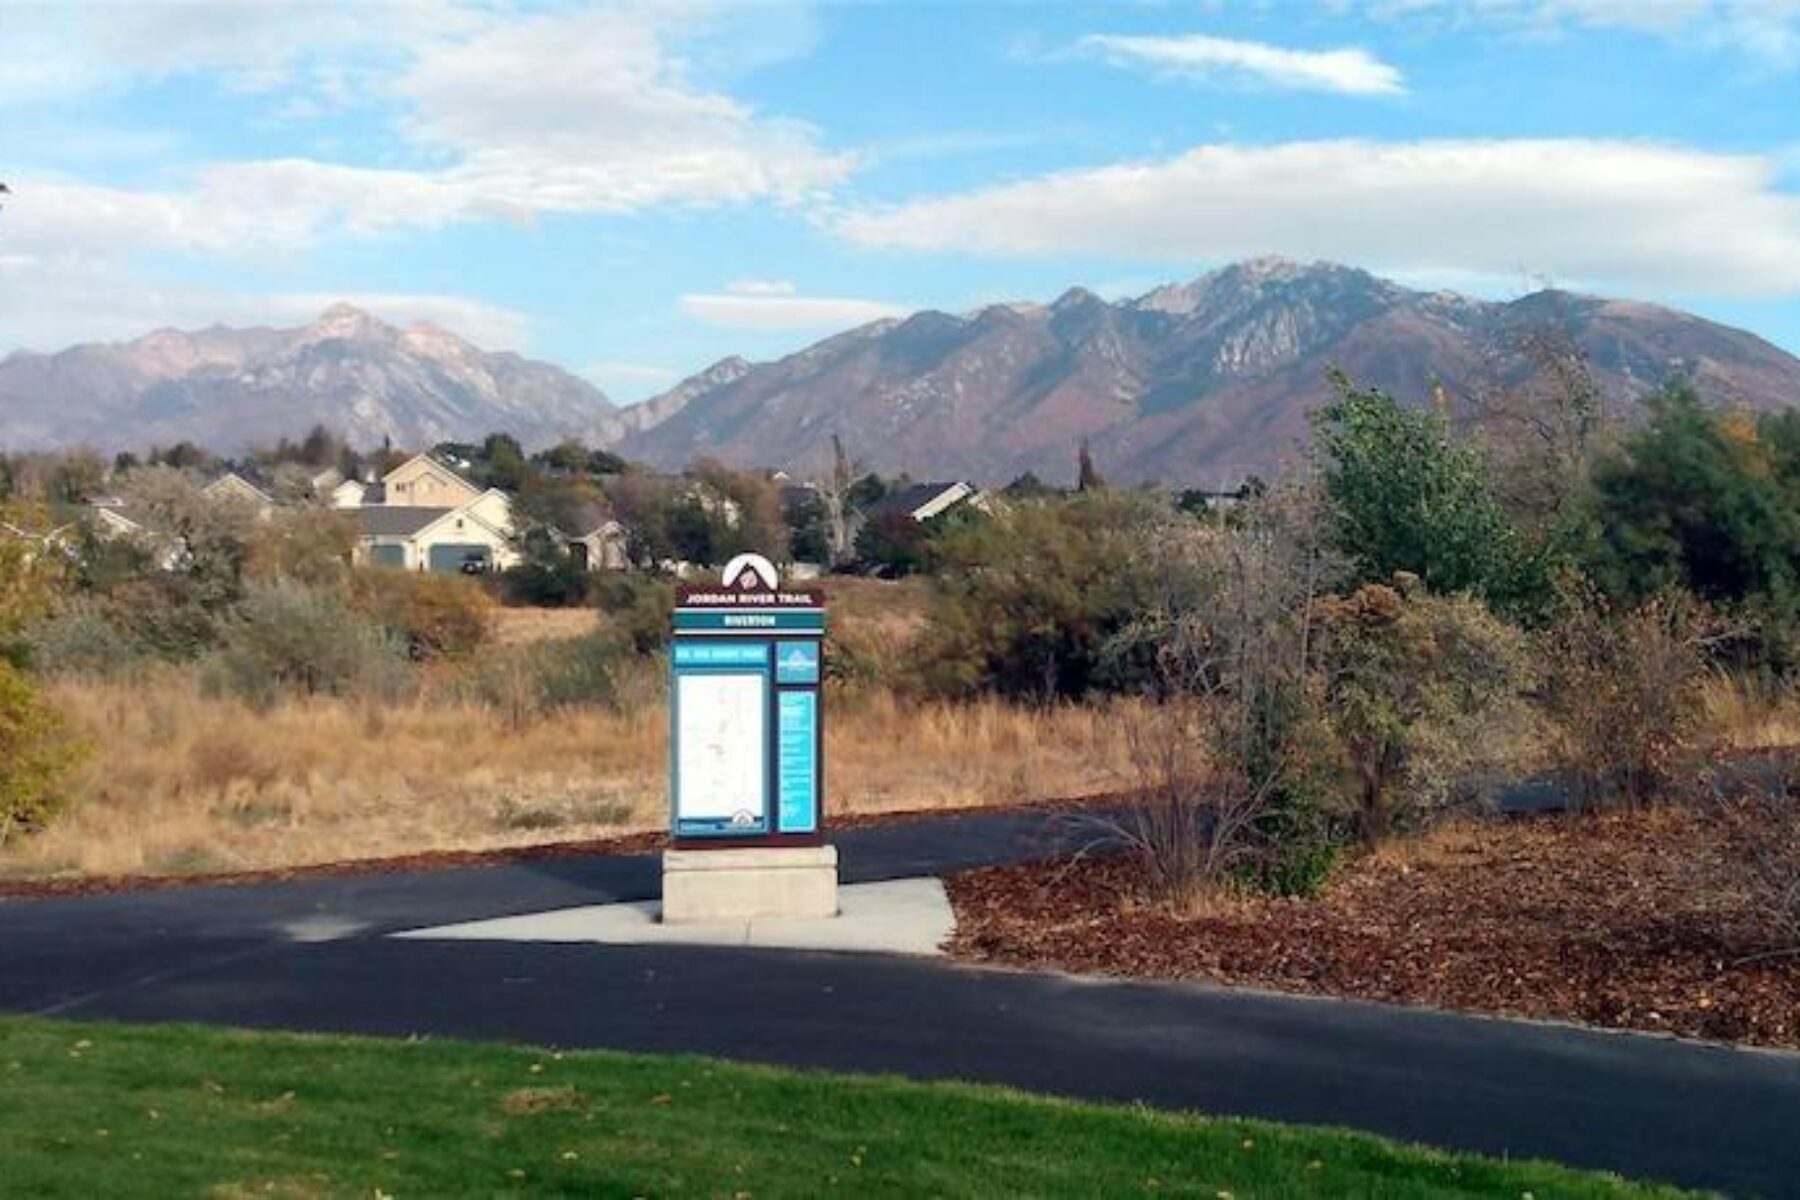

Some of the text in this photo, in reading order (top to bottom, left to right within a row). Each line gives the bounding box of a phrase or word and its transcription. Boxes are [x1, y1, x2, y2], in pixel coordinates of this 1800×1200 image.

[686, 593, 812, 604] JORDAN RIVER TRAIL
[724, 615, 776, 626] RIVERTON
